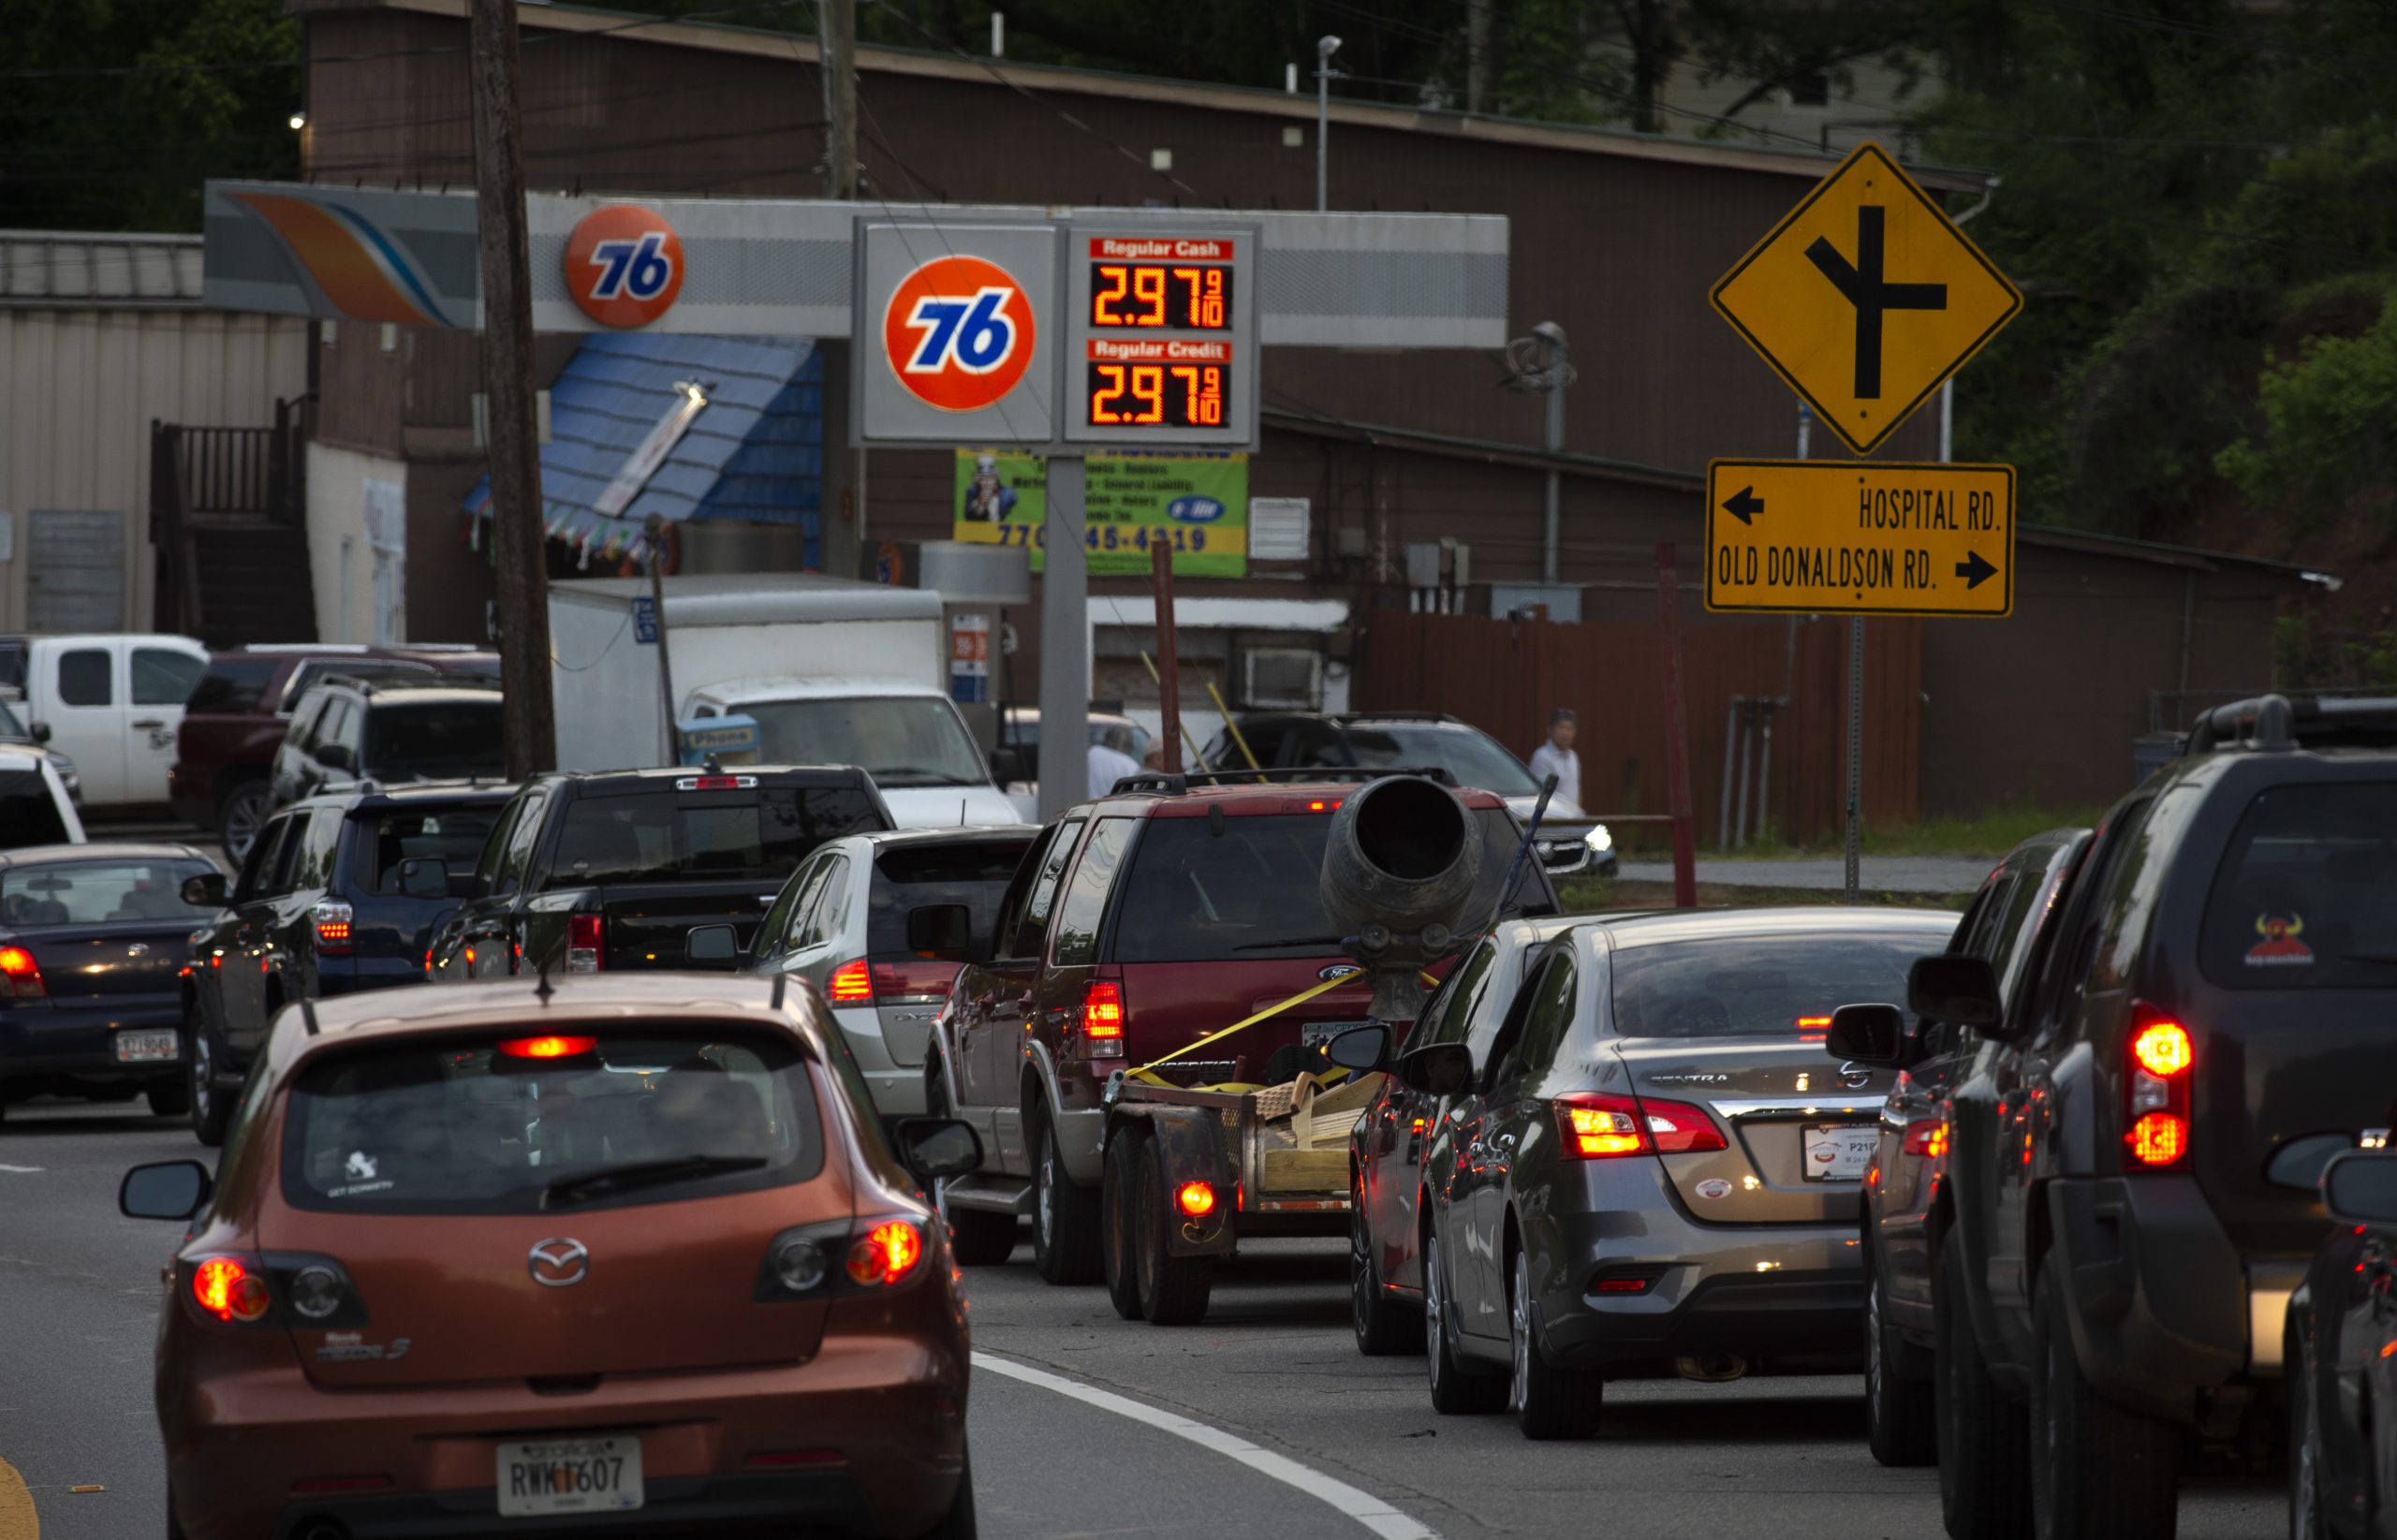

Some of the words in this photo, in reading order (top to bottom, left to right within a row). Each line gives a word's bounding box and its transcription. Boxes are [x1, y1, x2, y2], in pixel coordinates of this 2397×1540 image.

[588, 230, 672, 301] 76
[1102, 240, 1170, 258] Regular
[1174, 240, 1221, 257] Cash
[904, 285, 1018, 375] 76
[1094, 341, 1164, 359] Regular
[1167, 340, 1225, 359] Credit
[1859, 487, 1959, 531] HOSPITAL
[1967, 491, 2001, 532] RD.
[1718, 545, 1758, 585] OLD
[1768, 546, 1894, 589] DONALDSON
[1904, 550, 1937, 590] RD.
[694, 730, 748, 744] Phone
[1650, 1074, 1728, 1087] SENTRA
[510, 1457, 624, 1497] RWK1607
